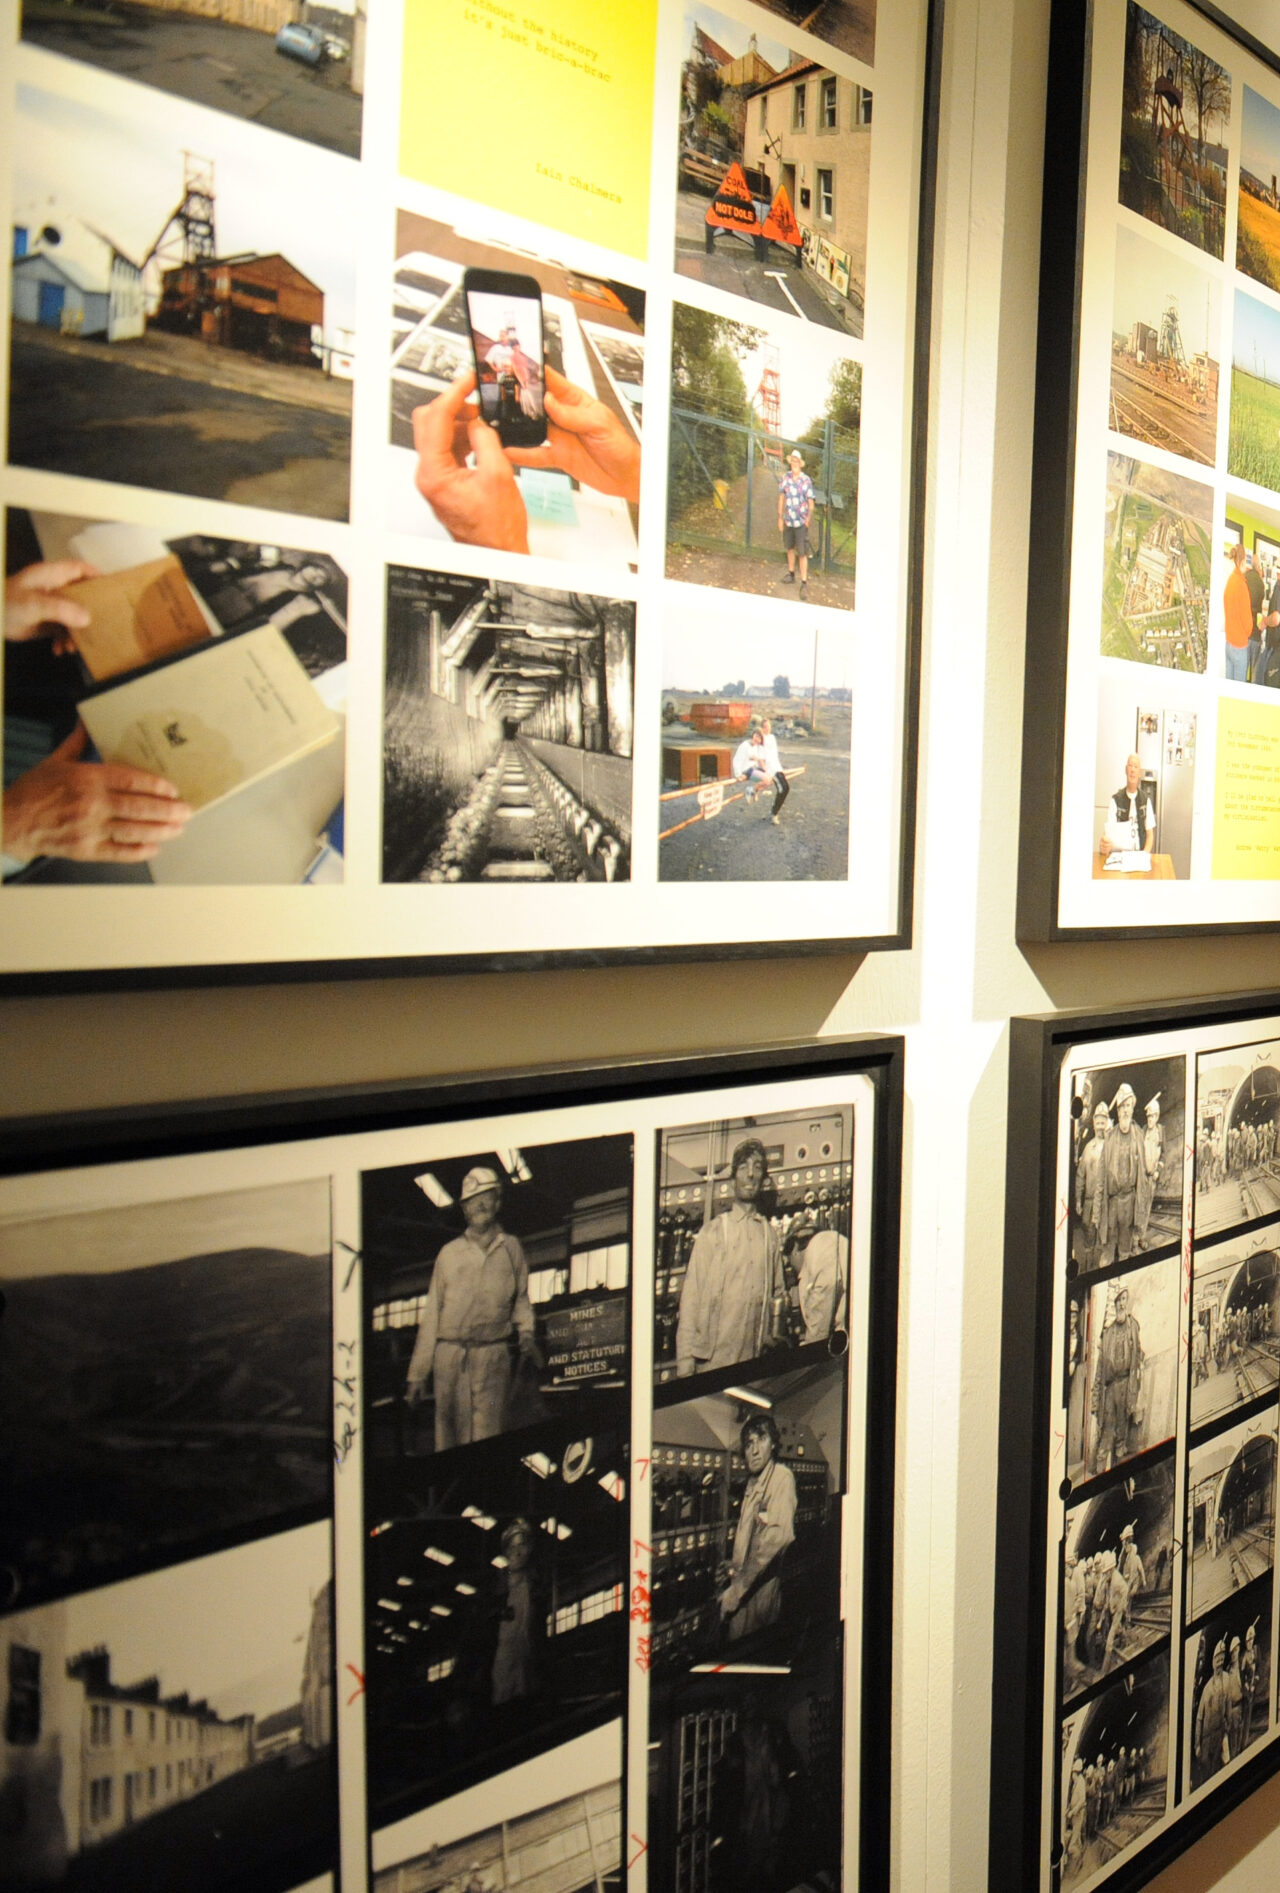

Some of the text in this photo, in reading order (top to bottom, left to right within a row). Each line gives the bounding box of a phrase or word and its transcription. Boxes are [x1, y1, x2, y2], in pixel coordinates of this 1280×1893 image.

[501, 26, 530, 47] just
[522, 18, 544, 36] the
[550, 29, 598, 62] history
[568, 175, 623, 205] Chalmers
[715, 200, 755, 223] NOT DOLE
[569, 1305, 604, 1322] MINES
[547, 1344, 626, 1366] AND STATUTORY
[564, 1361, 608, 1378] NOTICES
